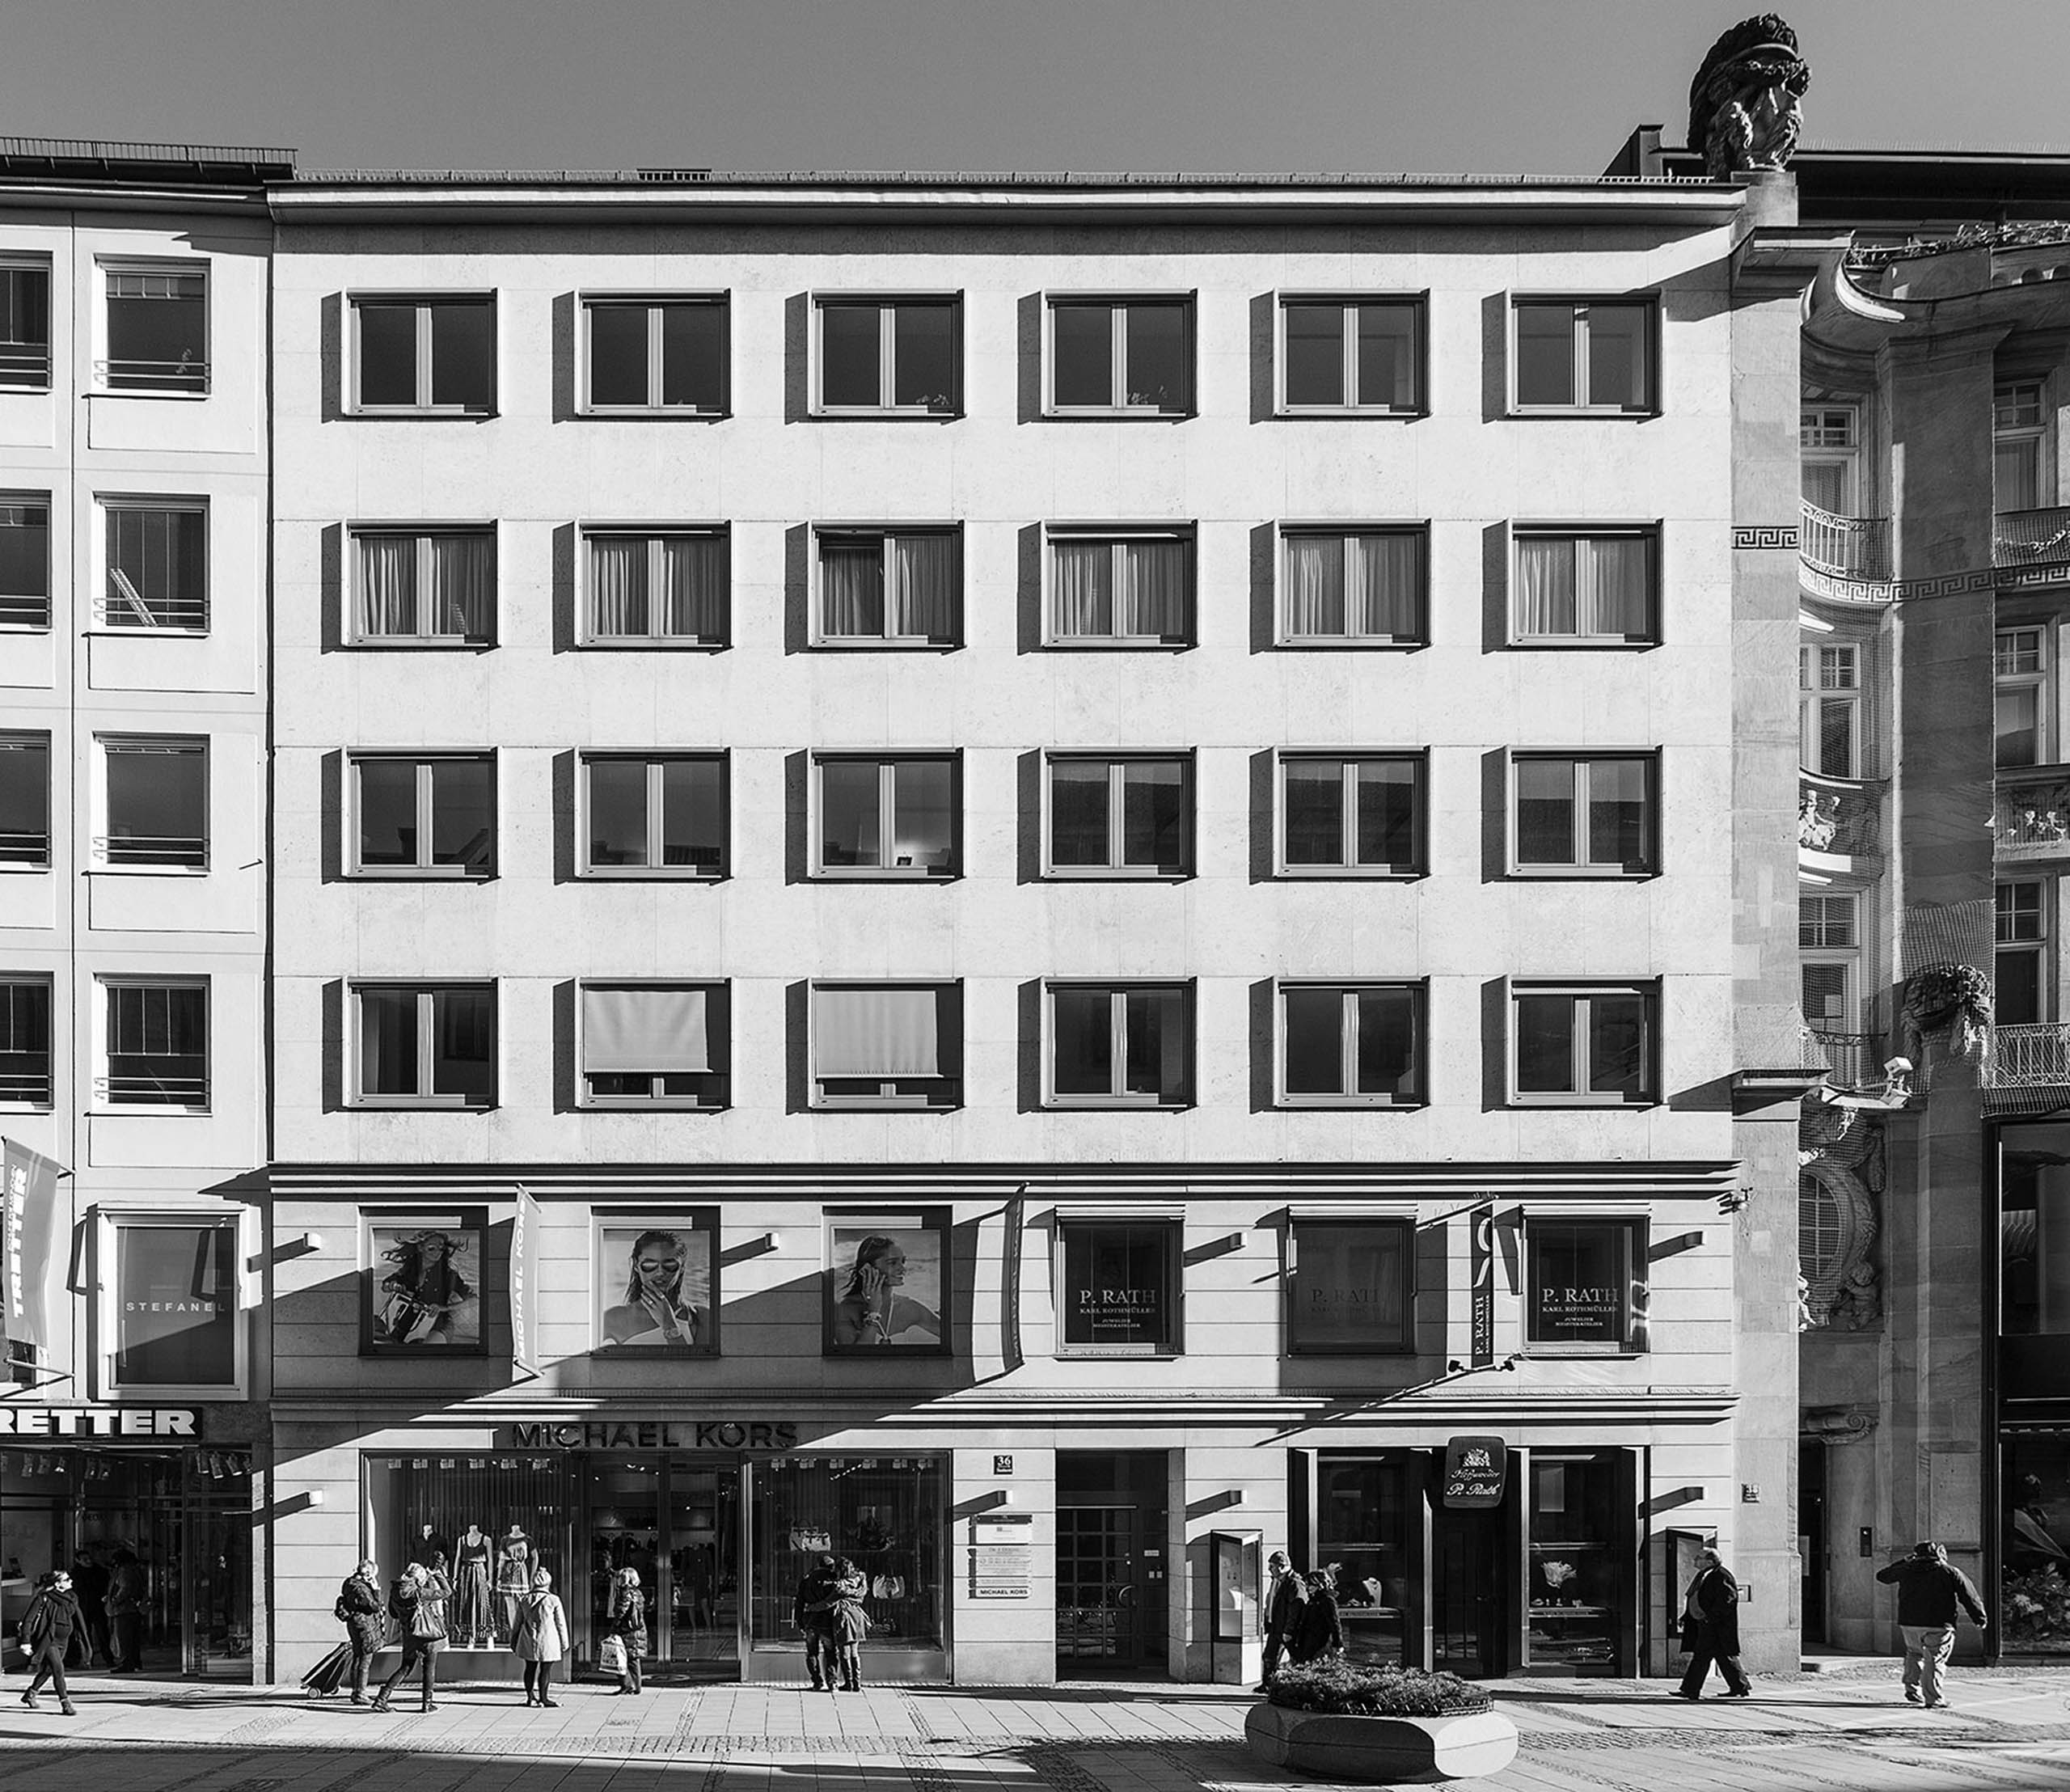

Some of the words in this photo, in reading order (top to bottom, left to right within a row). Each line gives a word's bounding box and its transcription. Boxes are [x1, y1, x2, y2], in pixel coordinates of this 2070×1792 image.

[10, 1167, 27, 1318] TRETTER
[1079, 1289, 1096, 1304] P.
[1101, 1289, 1155, 1304] RATH
[1541, 1287, 1560, 1303] P.
[1564, 1287, 1618, 1303] RATH
[125, 1301, 226, 1312] STEFANEL
[514, 1266, 526, 1360] MICHAEL
[1474, 1295, 1485, 1339] RATH
[513, 1422, 680, 1448] MICHAEL
[695, 1422, 797, 1448] KORS
[996, 1456, 1012, 1465] 36
